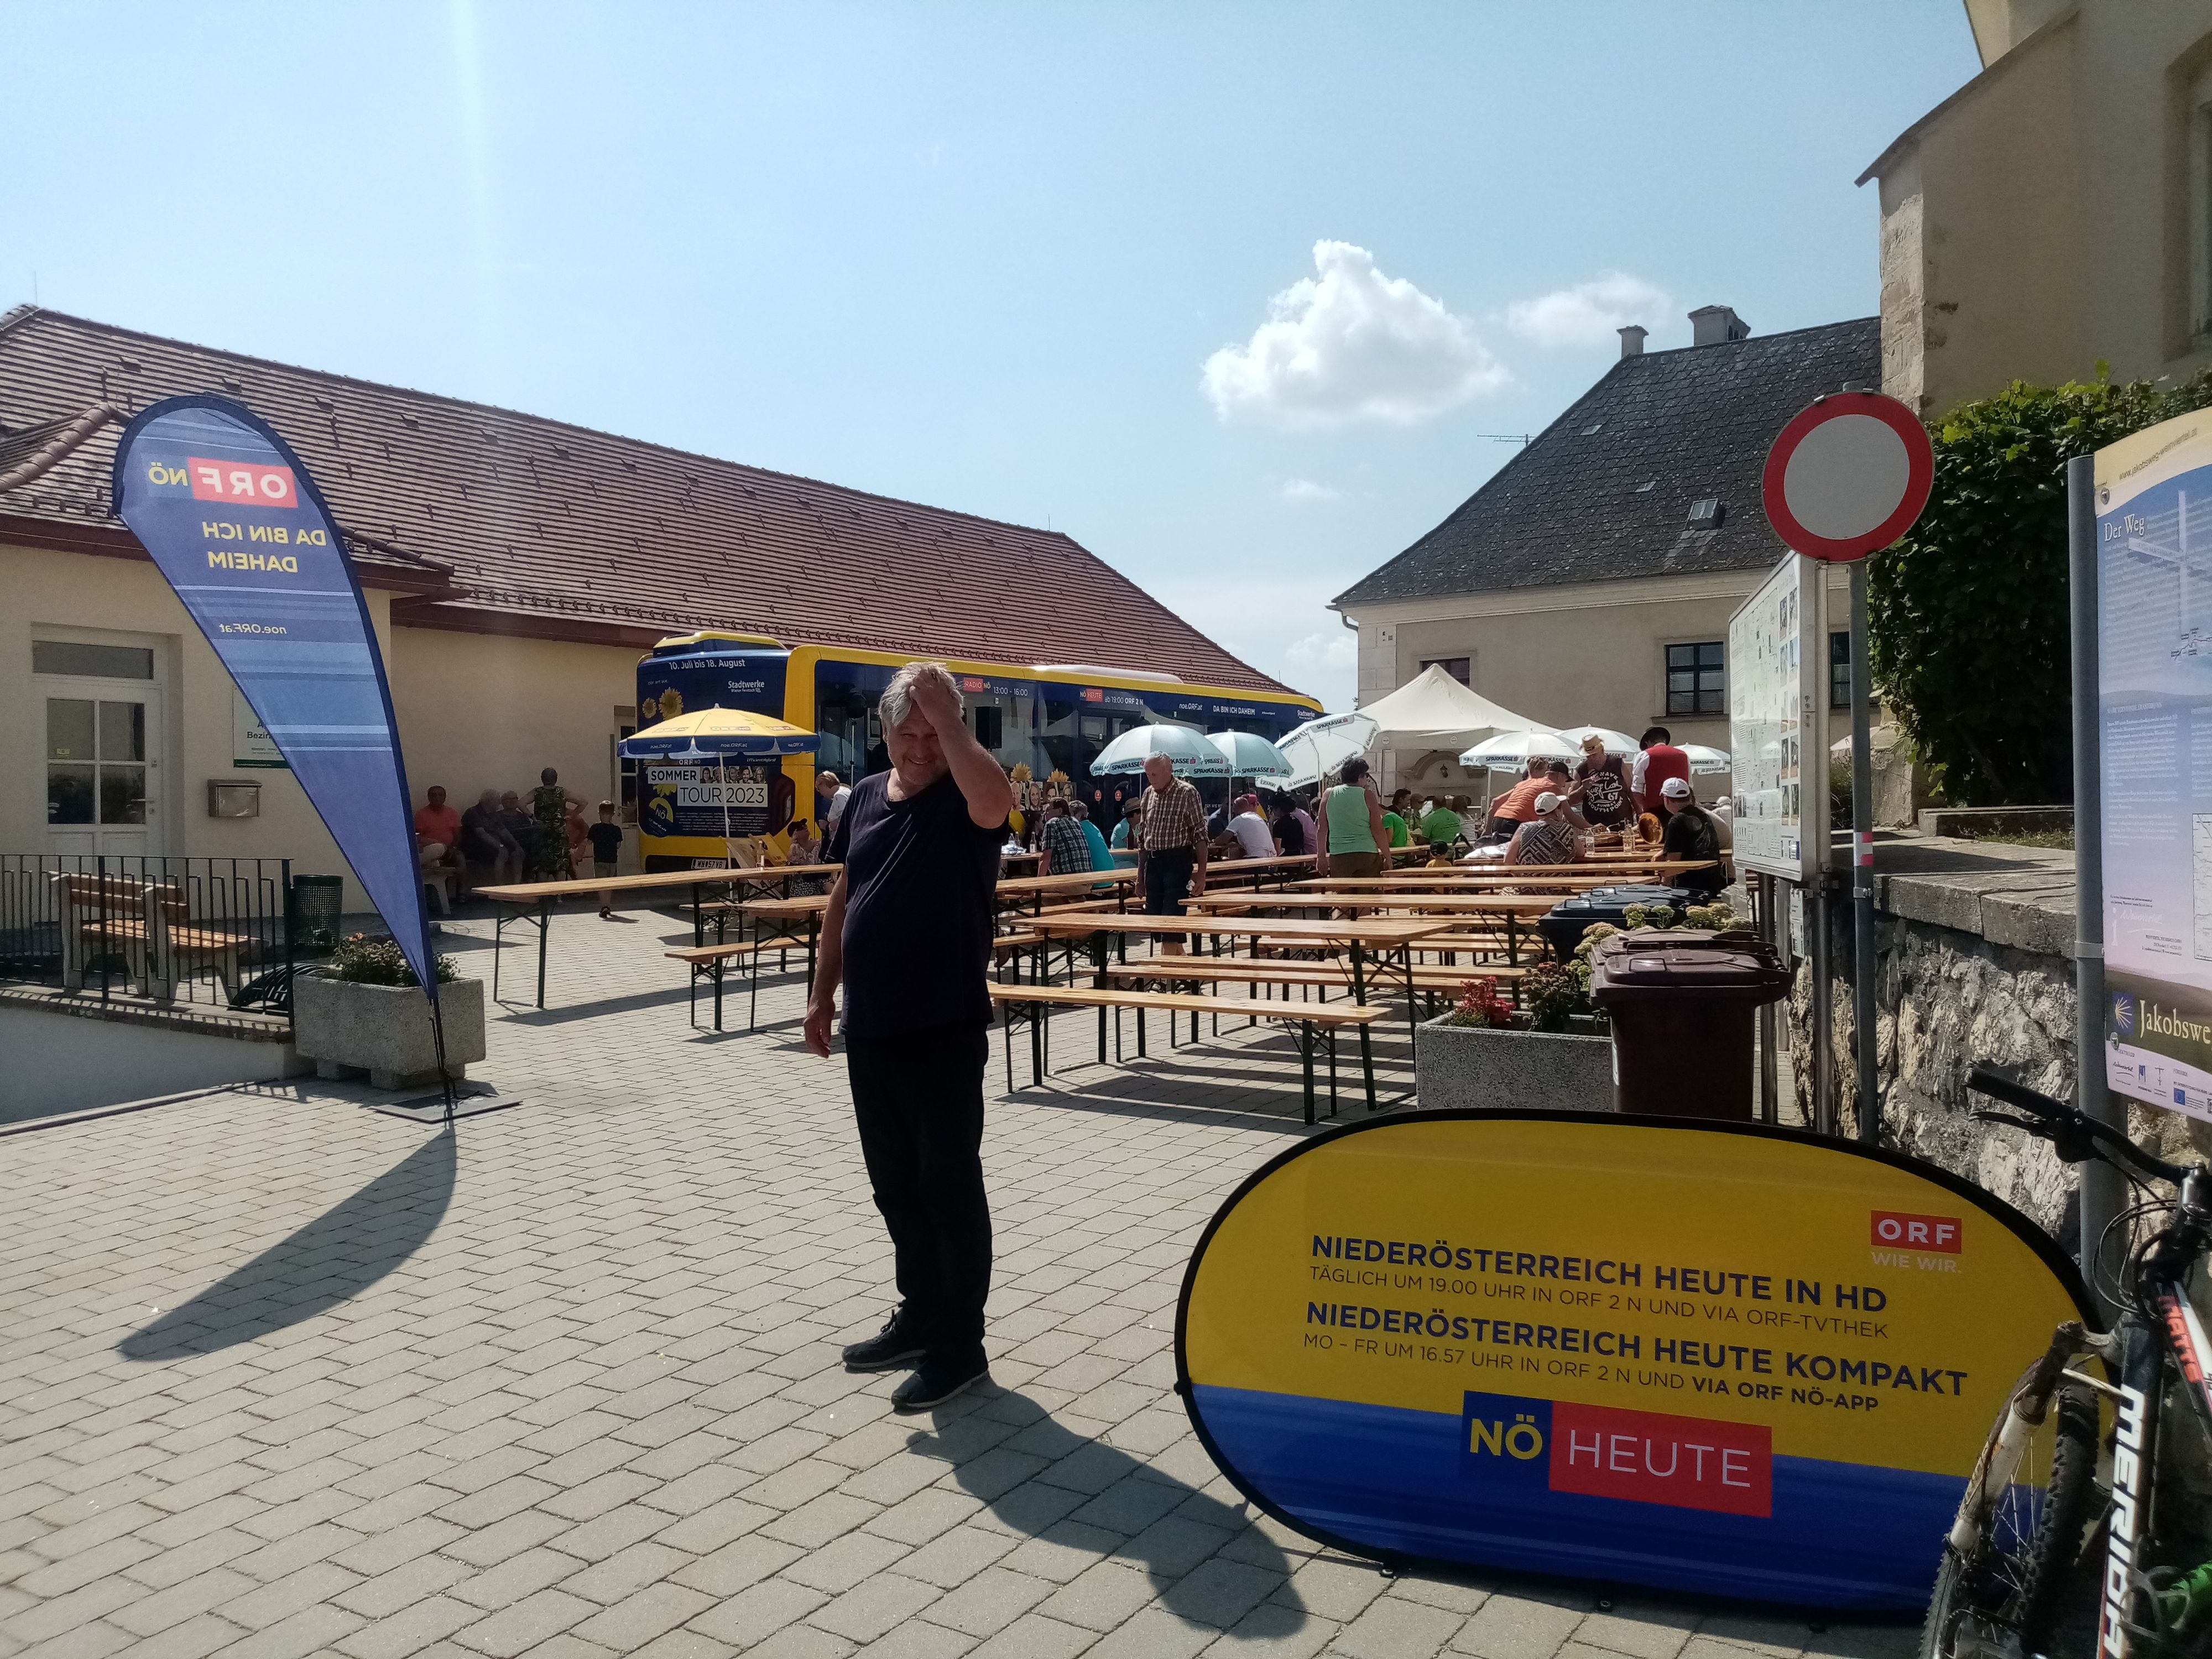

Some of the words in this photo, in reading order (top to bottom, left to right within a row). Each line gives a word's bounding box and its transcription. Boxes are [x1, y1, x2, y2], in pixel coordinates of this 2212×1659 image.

[2104, 522, 2122, 542] Der
[2124, 513, 2145, 536] Weg
[669, 662, 680, 670] 10.
[681, 660, 693, 670] Juli
[695, 660, 706, 669] bis
[707, 660, 717, 668] 18.
[718, 659, 745, 670] August
[728, 680, 765, 689] Stadtwerke
[965, 681, 982, 689] RADIO
[993, 686, 1008, 695] 13:00
[1178, 703, 1203, 711] noe.ORF.at
[1238, 707, 1255, 716] DAHEIM
[1316, 719, 1343, 730] SPARKASSE
[1111, 761, 1140, 771] SPARKASSE
[651, 770, 697, 781] SOMMER
[680, 787, 722, 803] TOUR
[726, 787, 764, 804] 2023
[1607, 791, 1619, 801] 67
[655, 808, 666, 820] NÖ
[2140, 999, 2212, 1045] Jakobswe
[1878, 1218, 1955, 1245] ORF
[1871, 1251, 1910, 1269] WIE
[1917, 1256, 1962, 1274] WIR.
[1312, 1234, 1641, 1287] NIEDERÖSTERREICH
[1655, 1265, 1772, 1301] HEUTE
[1786, 1278, 1820, 1306] IN
[1835, 1284, 1887, 1312] HD
[1310, 1265, 1387, 1287] TÄGLICH
[1394, 1274, 1422, 1290] UM
[1429, 1277, 1477, 1295] 19.00
[1484, 1283, 1525, 1300] UHR
[1533, 1287, 1552, 1303] IN
[1559, 1290, 1601, 1307] ORF
[1609, 1295, 1620, 1310] 2
[1627, 1297, 1641, 1312] N
[1650, 1298, 1695, 1317] UND
[1703, 1304, 1739, 1323] VIA
[1747, 1309, 1888, 1339] ORF-TVTHEK
[1306, 1301, 1640, 1359] NIEDERÖSTERREICH
[1654, 1337, 1772, 1374] HEUTE
[1786, 1352, 1968, 1396] KOMPAKT
[1303, 1333, 1333, 1350] MO
[1354, 1339, 1378, 1355] FR
[1385, 1342, 1413, 1359] UM
[1420, 1345, 1465, 1364] 16.57
[1472, 1352, 1514, 1370] UHR
[1521, 1357, 1539, 1373] IN
[1547, 1359, 1590, 1378] ORF
[1597, 1365, 1608, 1381] 2
[1616, 1368, 1630, 1384] N
[1639, 1370, 1684, 1389] UND
[1692, 1376, 1730, 1396] VIA
[1738, 1382, 1783, 1401] ORF
[1791, 1386, 1879, 1411] NÖ-APP
[1469, 1413, 1543, 1460] NÖ
[1569, 1429, 1751, 1488] HEUTE
